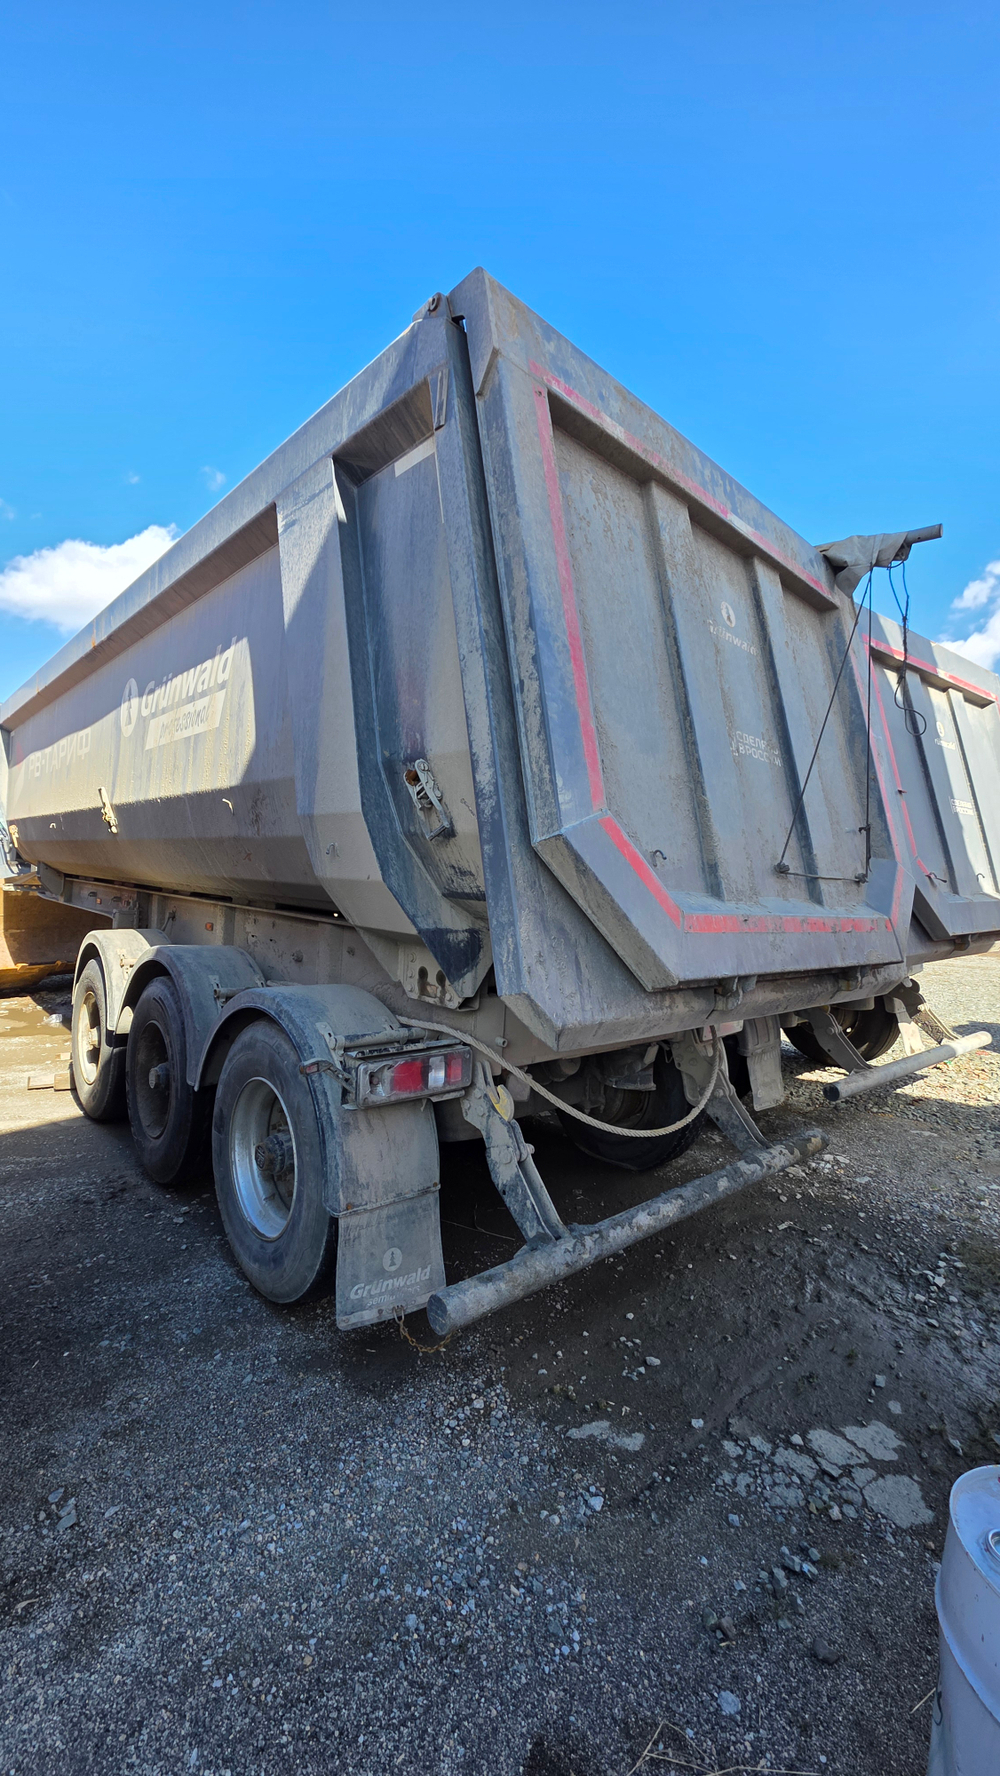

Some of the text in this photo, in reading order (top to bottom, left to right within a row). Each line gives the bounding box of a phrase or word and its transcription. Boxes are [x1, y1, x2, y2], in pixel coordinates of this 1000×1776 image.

[140, 635, 239, 717] Grünwald
[28, 727, 92, 780] РВ-ТАРИФ
[735, 730, 779, 755] СДЕЛАО
